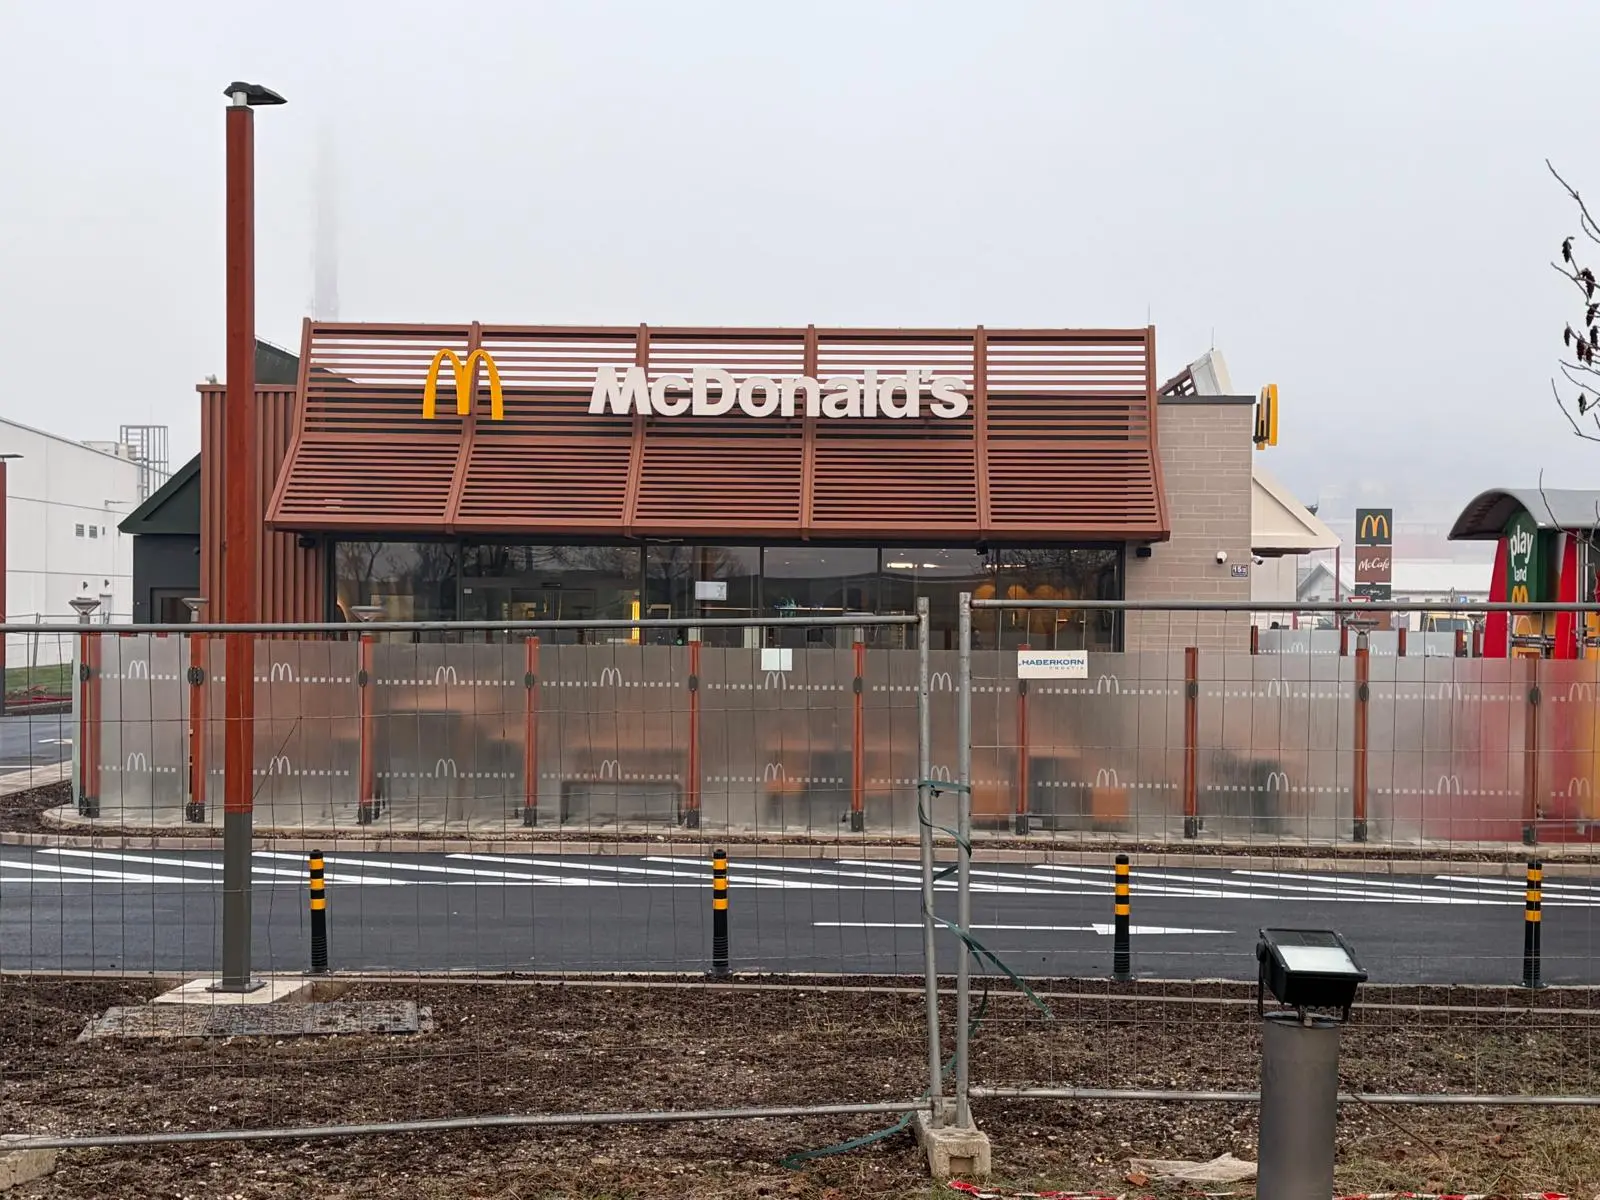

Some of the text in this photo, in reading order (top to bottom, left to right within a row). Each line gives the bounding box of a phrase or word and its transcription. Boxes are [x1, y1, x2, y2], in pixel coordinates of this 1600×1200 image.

[588, 366, 969, 418] McDonald's
[1510, 525, 1534, 567] play
[1514, 566, 1527, 582] land
